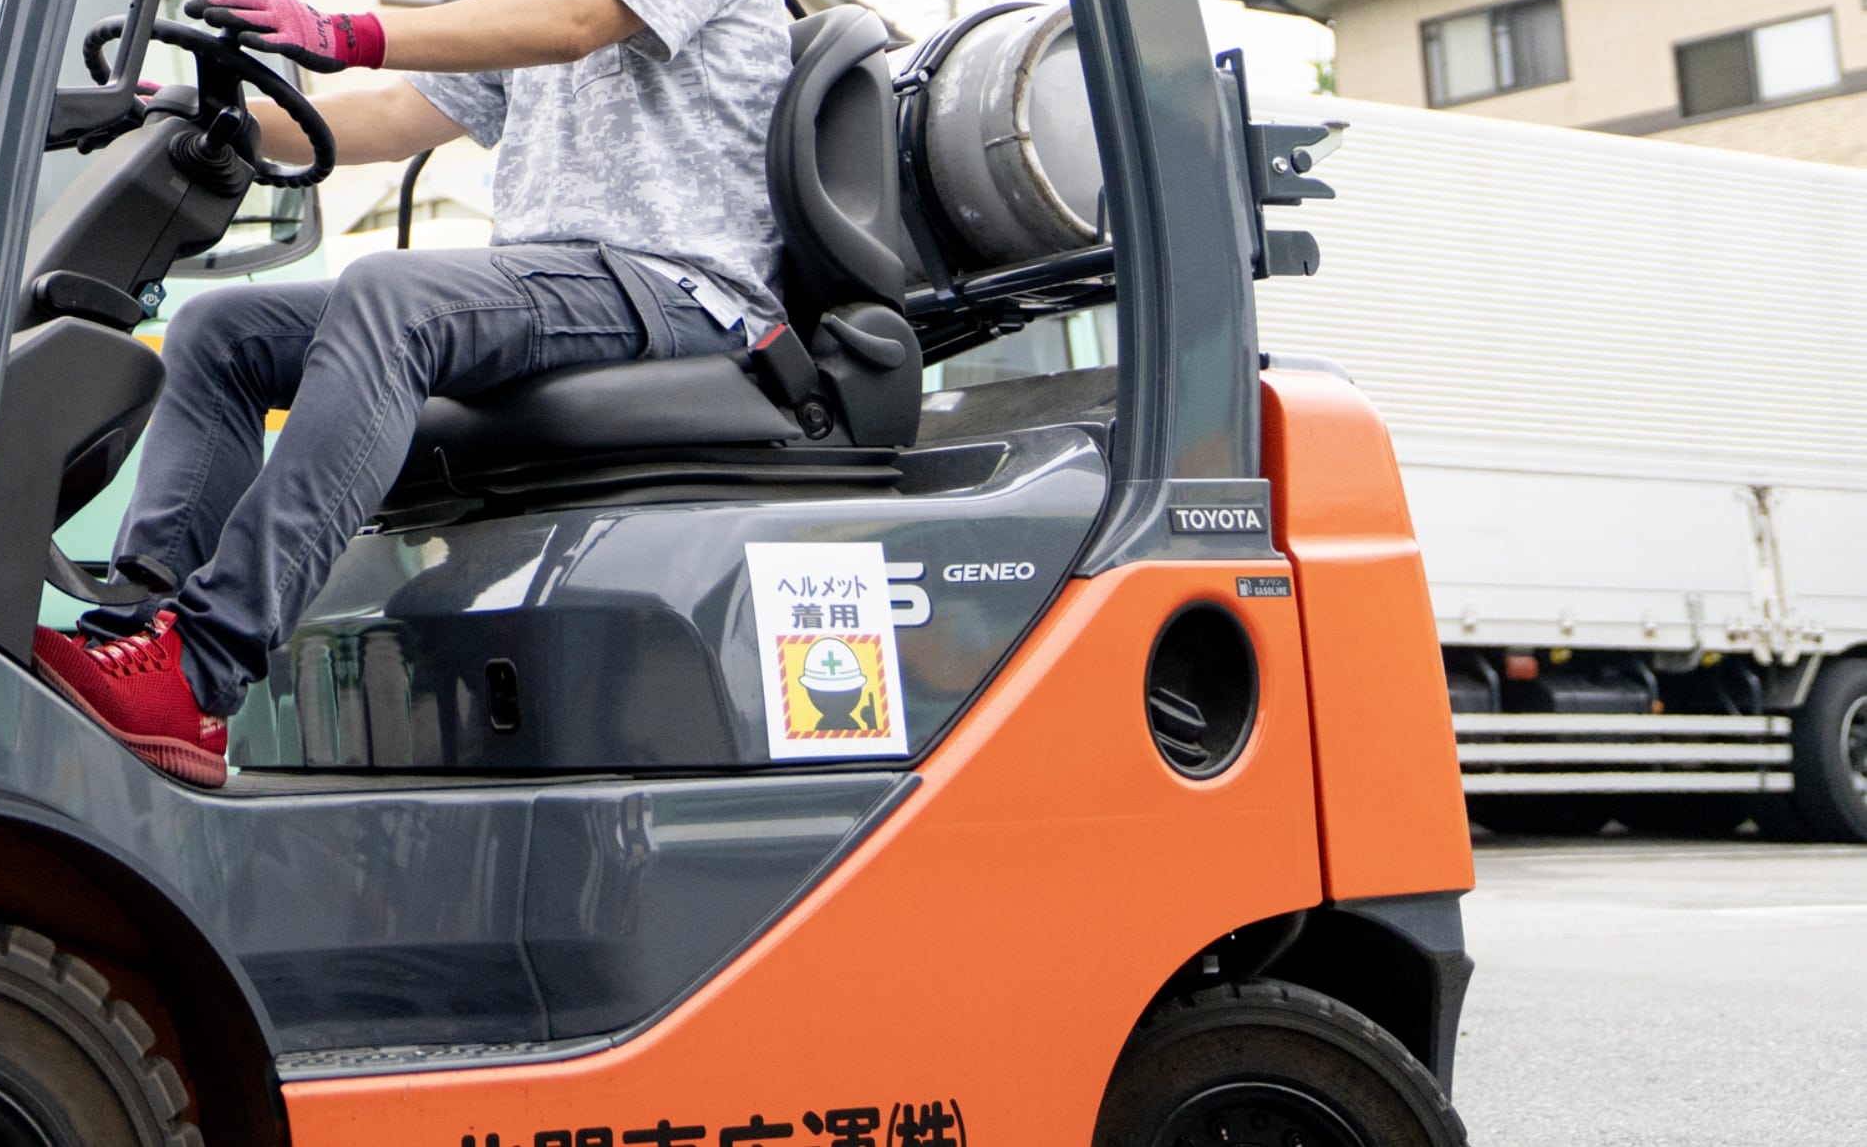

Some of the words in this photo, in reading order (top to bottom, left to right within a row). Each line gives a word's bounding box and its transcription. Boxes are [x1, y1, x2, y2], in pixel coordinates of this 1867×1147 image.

[1176, 509, 1262, 529] TOYOTA
[943, 562, 1035, 582] GENEO
[777, 575, 868, 599] ヘルメット
[1254, 586, 1288, 596] GASOLINE
[791, 603, 860, 629] 着用
